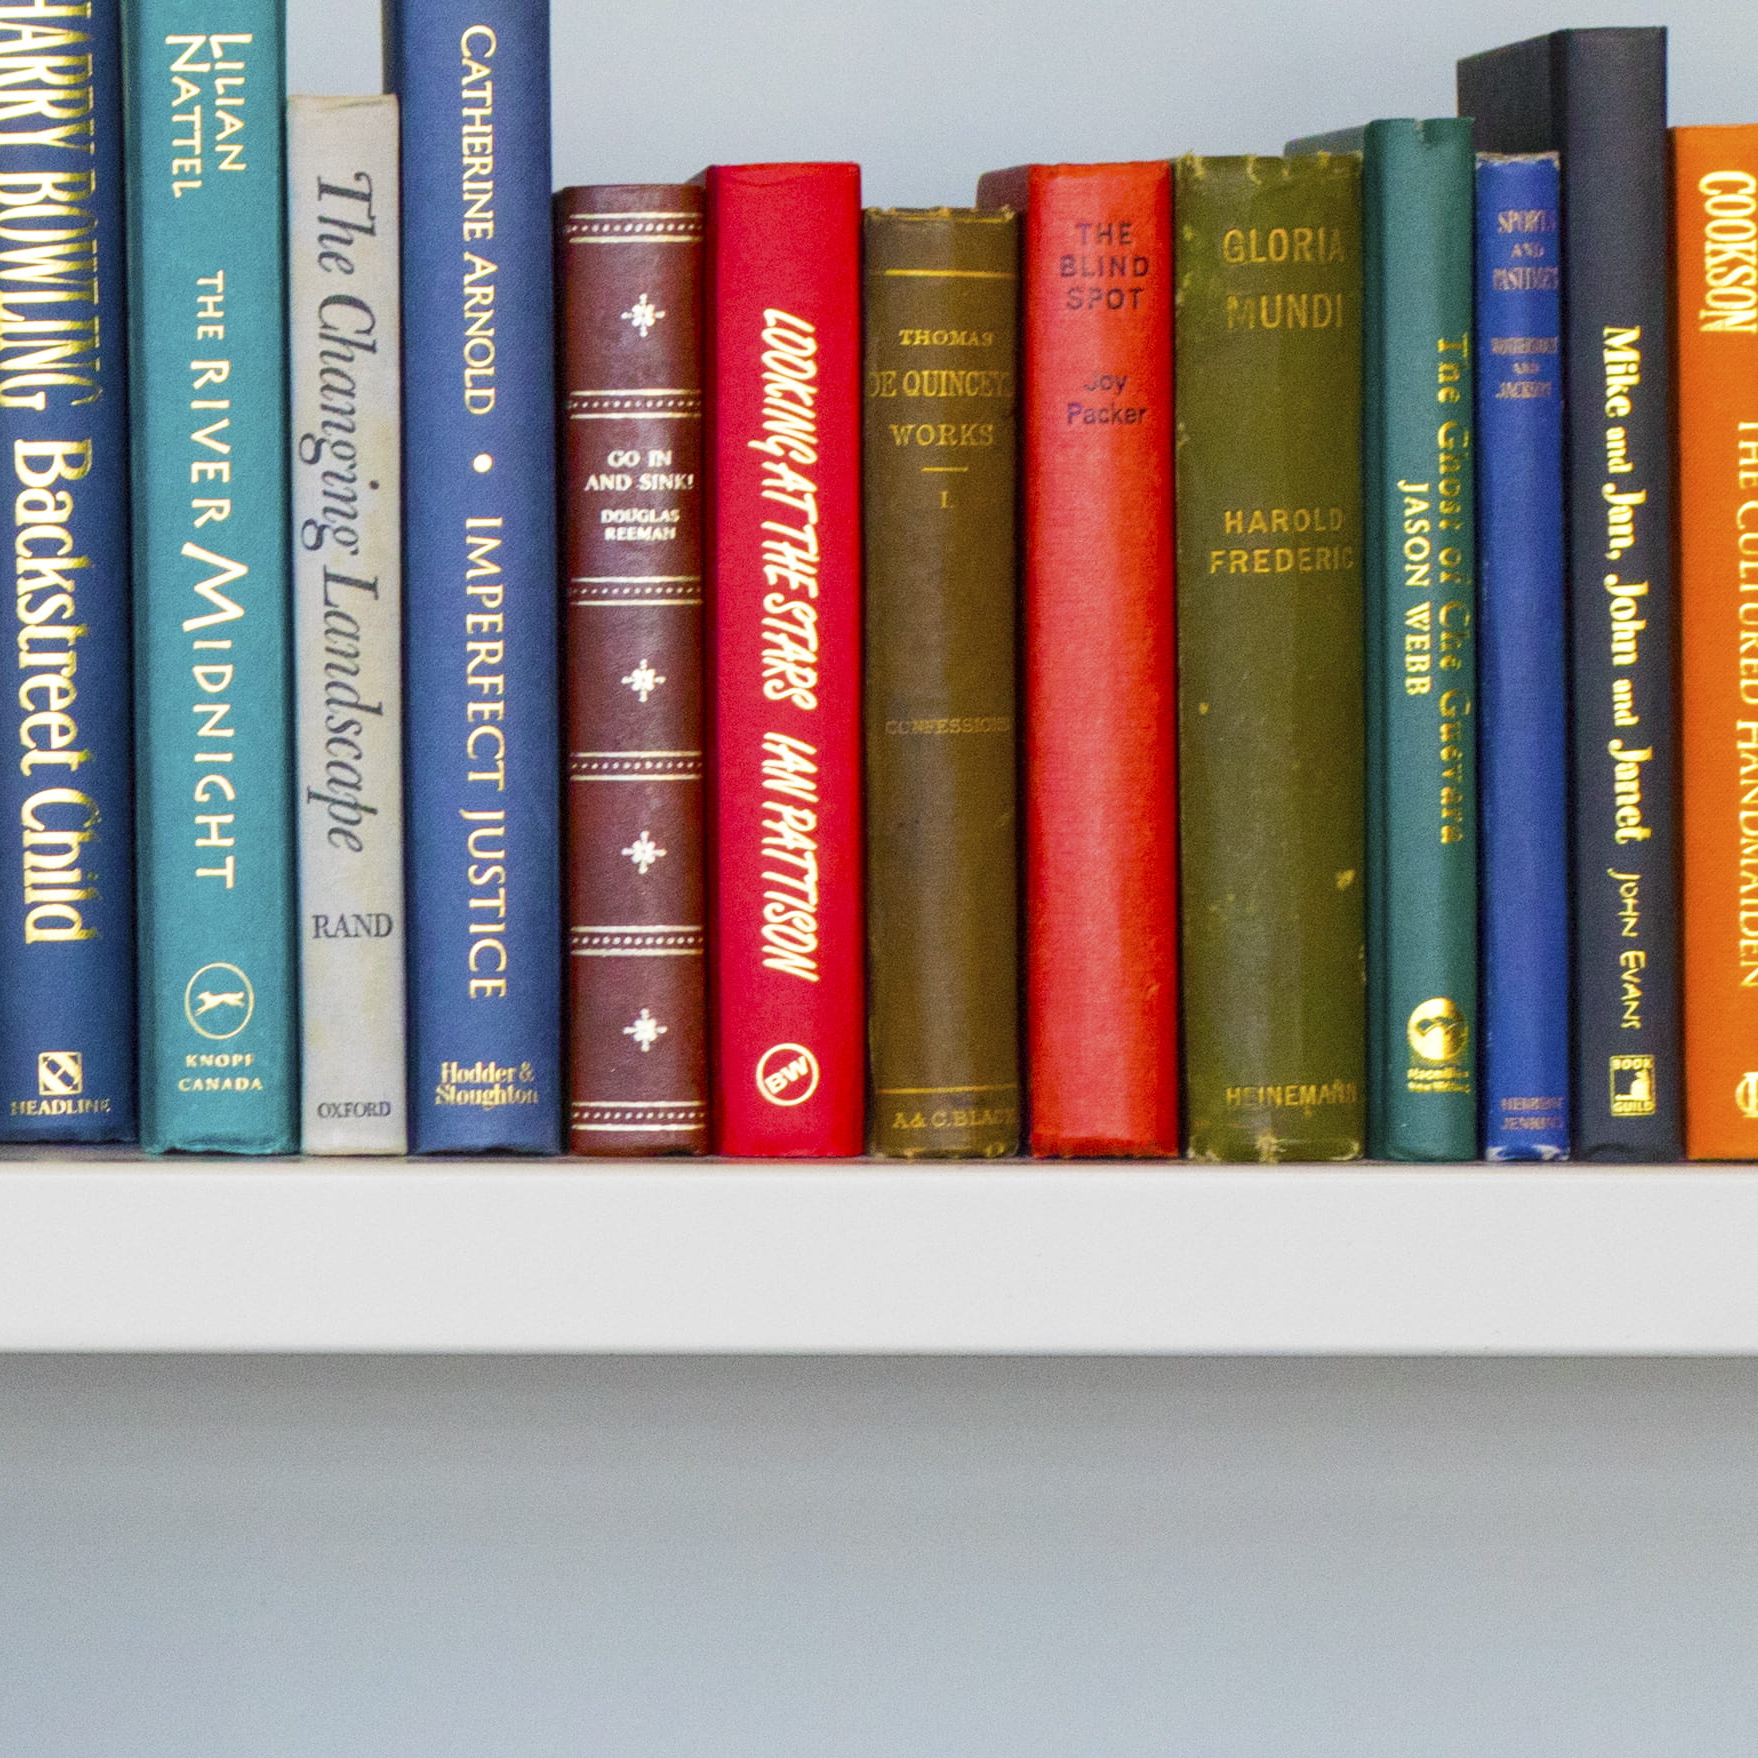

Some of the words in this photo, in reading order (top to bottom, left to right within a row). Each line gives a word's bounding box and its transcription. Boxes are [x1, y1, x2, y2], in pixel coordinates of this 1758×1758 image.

[460, 24, 498, 241] CATHERINE
[317, 171, 376, 275] The
[1075, 223, 1133, 245] THE
[1060, 255, 1149, 278] BLIND
[1066, 288, 1145, 310] SPOT
[197, 270, 225, 341] THE
[464, 252, 498, 415] ARNOLD
[1602, 326, 1641, 418] Mike
[190, 359, 231, 527] RIVER
[298, 294, 380, 556] Changing
[608, 450, 641, 468] GO
[648, 450, 672, 467] IN
[1606, 427, 1633, 474] and
[586, 473, 631, 491] AND
[1225, 510, 1344, 534] HAROLD
[1397, 480, 1431, 586] JASON
[465, 517, 506, 791] IMPERFECT
[1405, 601, 1430, 695] WEBB
[181, 541, 250, 889] MIDNIGHT
[307, 564, 383, 853] Landscape
[1612, 679, 1640, 727] and
[1608, 738, 1653, 845] Janet
[312, 914, 393, 939] RAND
[459, 810, 507, 1000] JUSTICE
[178, 1077, 262, 1091] CANADA
[186, 1054, 254, 1068] KNOPF
[764, 1057, 809, 1093] BW
[318, 1102, 391, 1118] OXFORD
